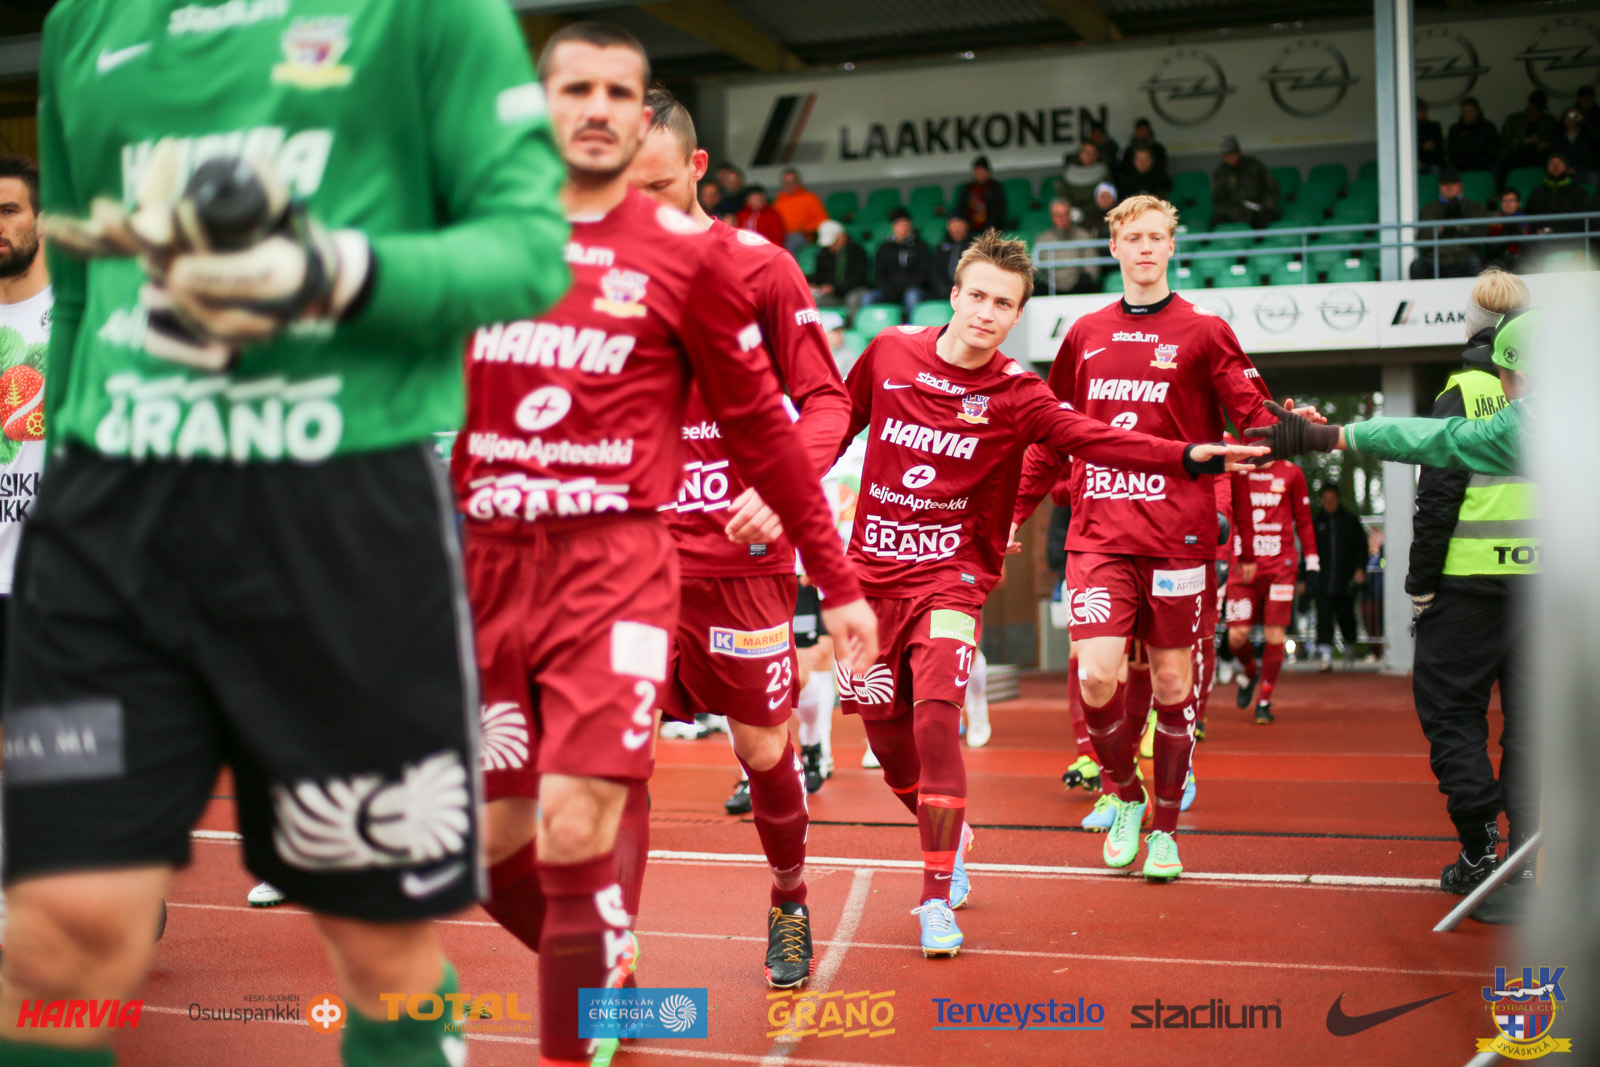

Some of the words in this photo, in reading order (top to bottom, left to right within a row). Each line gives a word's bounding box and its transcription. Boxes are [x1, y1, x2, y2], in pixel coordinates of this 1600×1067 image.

[840, 104, 1109, 161] LAAKKONEN
[474, 321, 636, 374] HARVIA
[1112, 331, 1159, 343] stadium
[915, 372, 966, 395] stadium
[1088, 378, 1170, 403] HARVIA
[880, 418, 979, 460] HARVIA
[869, 482, 969, 512] KeljonApteekki
[1086, 472, 1165, 494] GRANO
[865, 523, 960, 554] GRANO
[1195, 595, 1202, 617] 3
[716, 633, 731, 649] K
[743, 632, 784, 646] MARKET
[956, 645, 973, 674] 11
[766, 656, 792, 693] 23
[632, 680, 656, 726] 2
